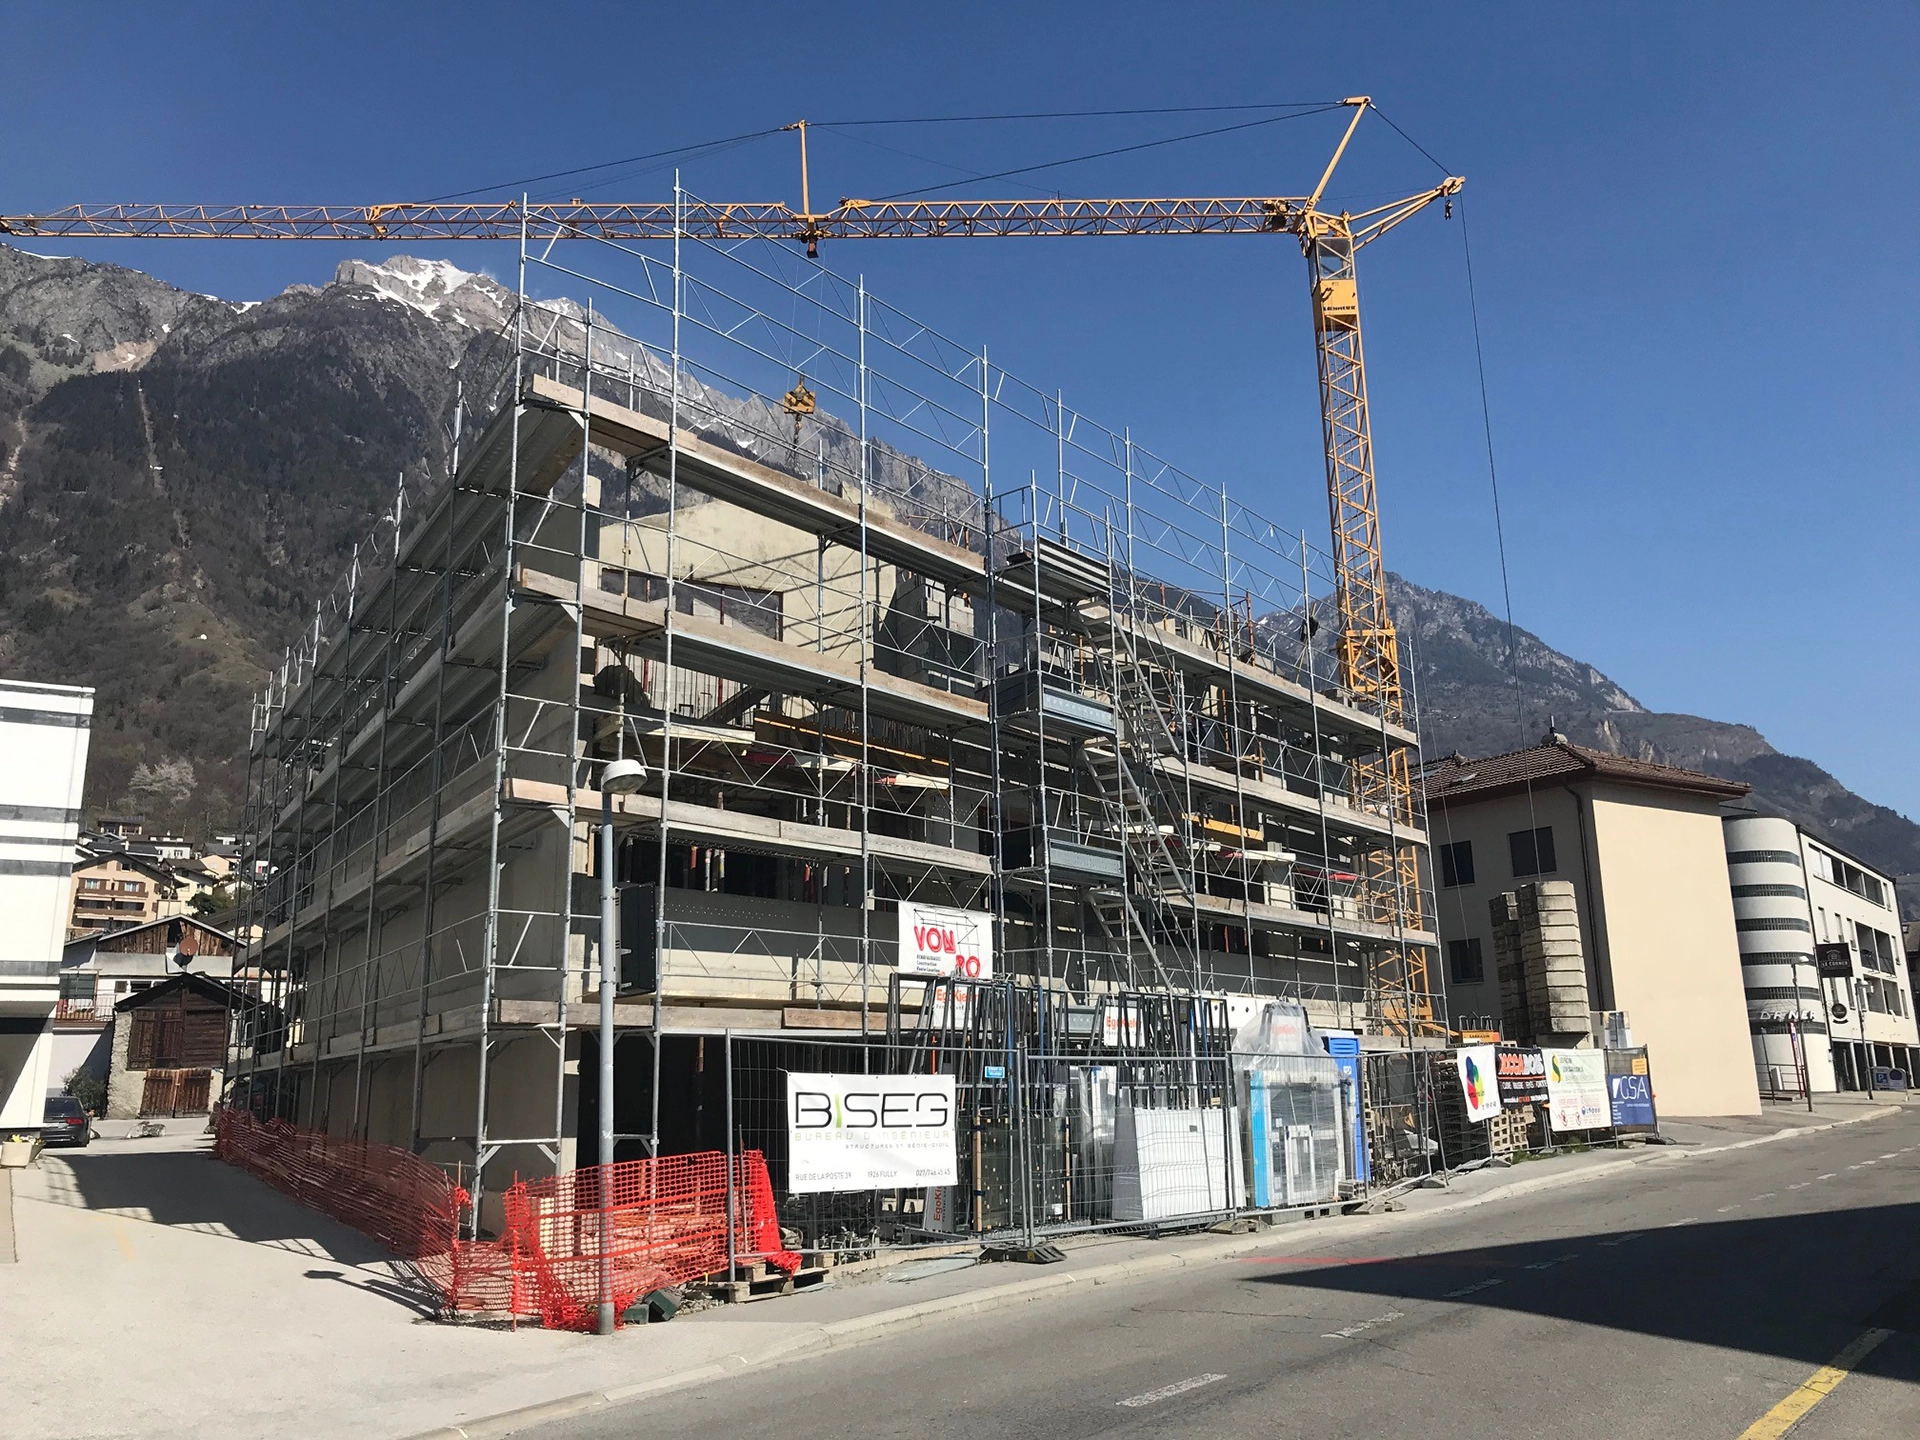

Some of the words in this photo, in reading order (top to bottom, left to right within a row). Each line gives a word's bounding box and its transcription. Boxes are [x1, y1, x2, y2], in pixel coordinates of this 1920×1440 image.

[913, 925, 956, 954] VON
[795, 1091, 949, 1129] BISEG
[794, 1131, 854, 1141] BUREAU
[795, 1173, 808, 1181] RUE
[808, 1173, 817, 1181] DE
[817, 1173, 826, 1181] LA
[825, 1172, 844, 1180] POSTE
[867, 1170, 879, 1178] 1926
[879, 1170, 898, 1178] FULLY
[933, 1186, 942, 1222] EgoKi
